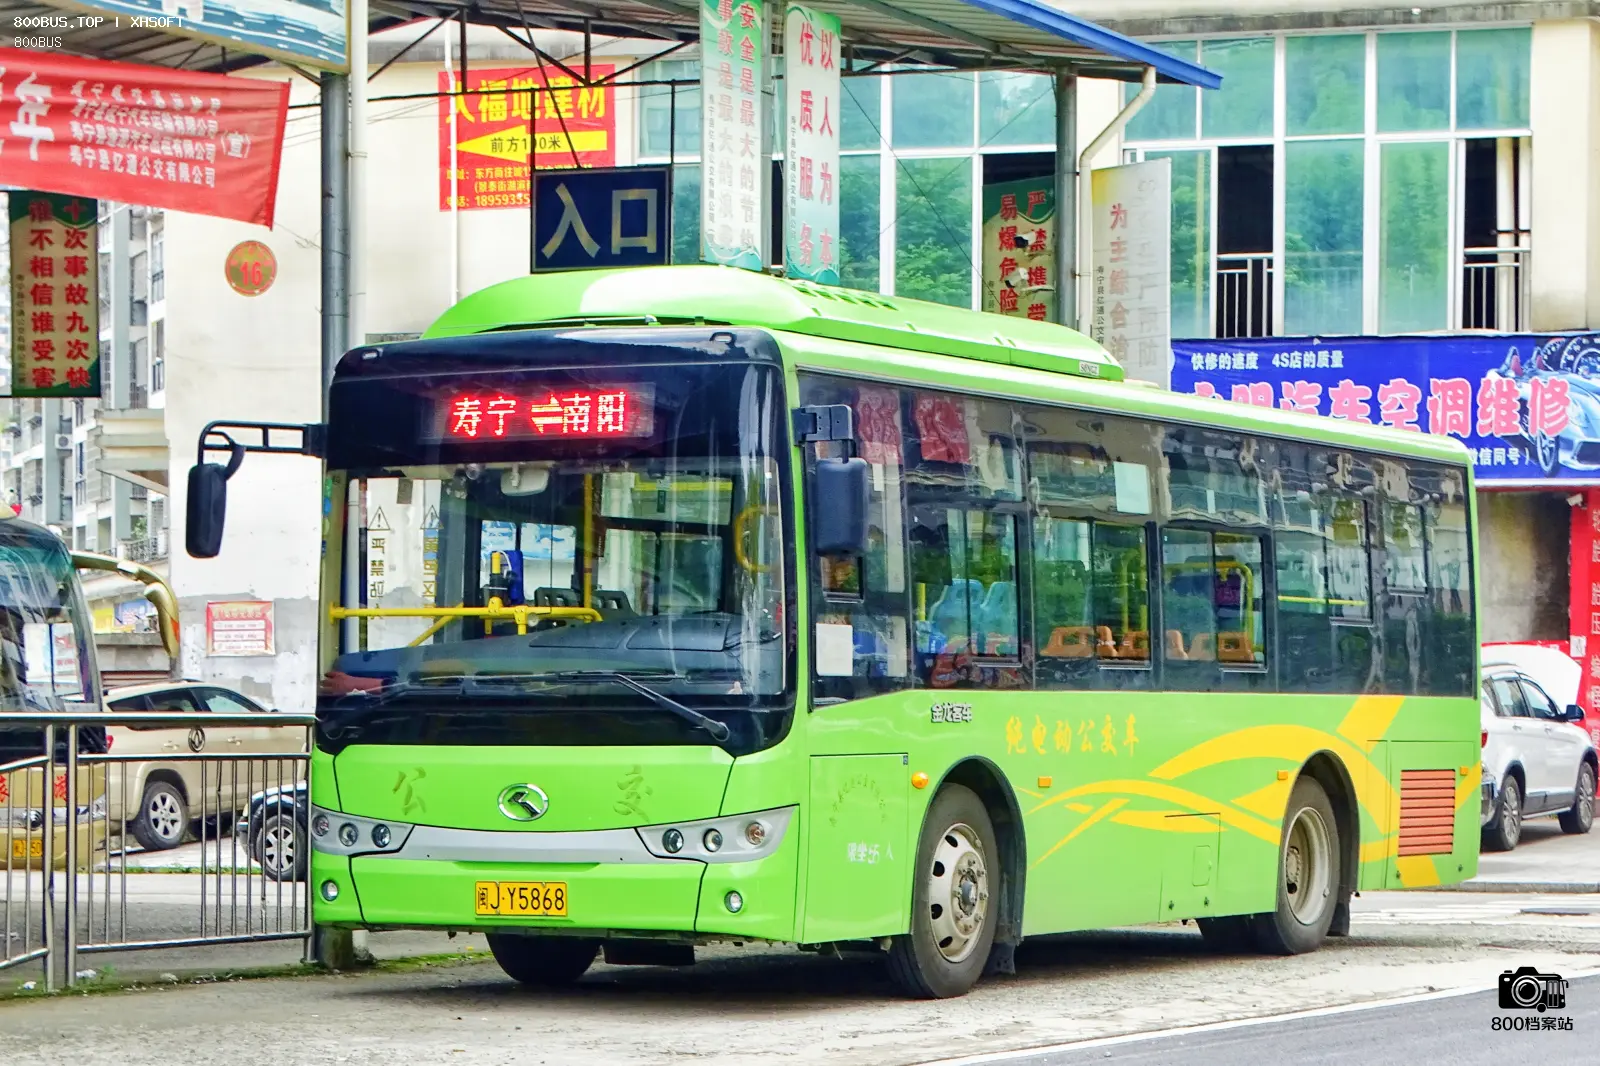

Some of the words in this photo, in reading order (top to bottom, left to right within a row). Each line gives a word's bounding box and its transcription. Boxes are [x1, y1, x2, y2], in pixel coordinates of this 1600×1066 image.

[799, 21, 815, 268] 优质服务
[819, 28, 834, 269] 以人为本
[541, 184, 658, 259] 入口
[63, 200, 91, 389] 十次事故九次快
[240, 261, 263, 287] 16
[1191, 352, 1259, 371] 快修的速度
[1272, 350, 1345, 369] 4S店的质量
[453, 397, 517, 437] 寿宁
[562, 391, 627, 434] 南阳
[1005, 713, 1140, 758] 纯电动公交车
[393, 766, 427, 816] 公
[613, 764, 653, 823] 交
